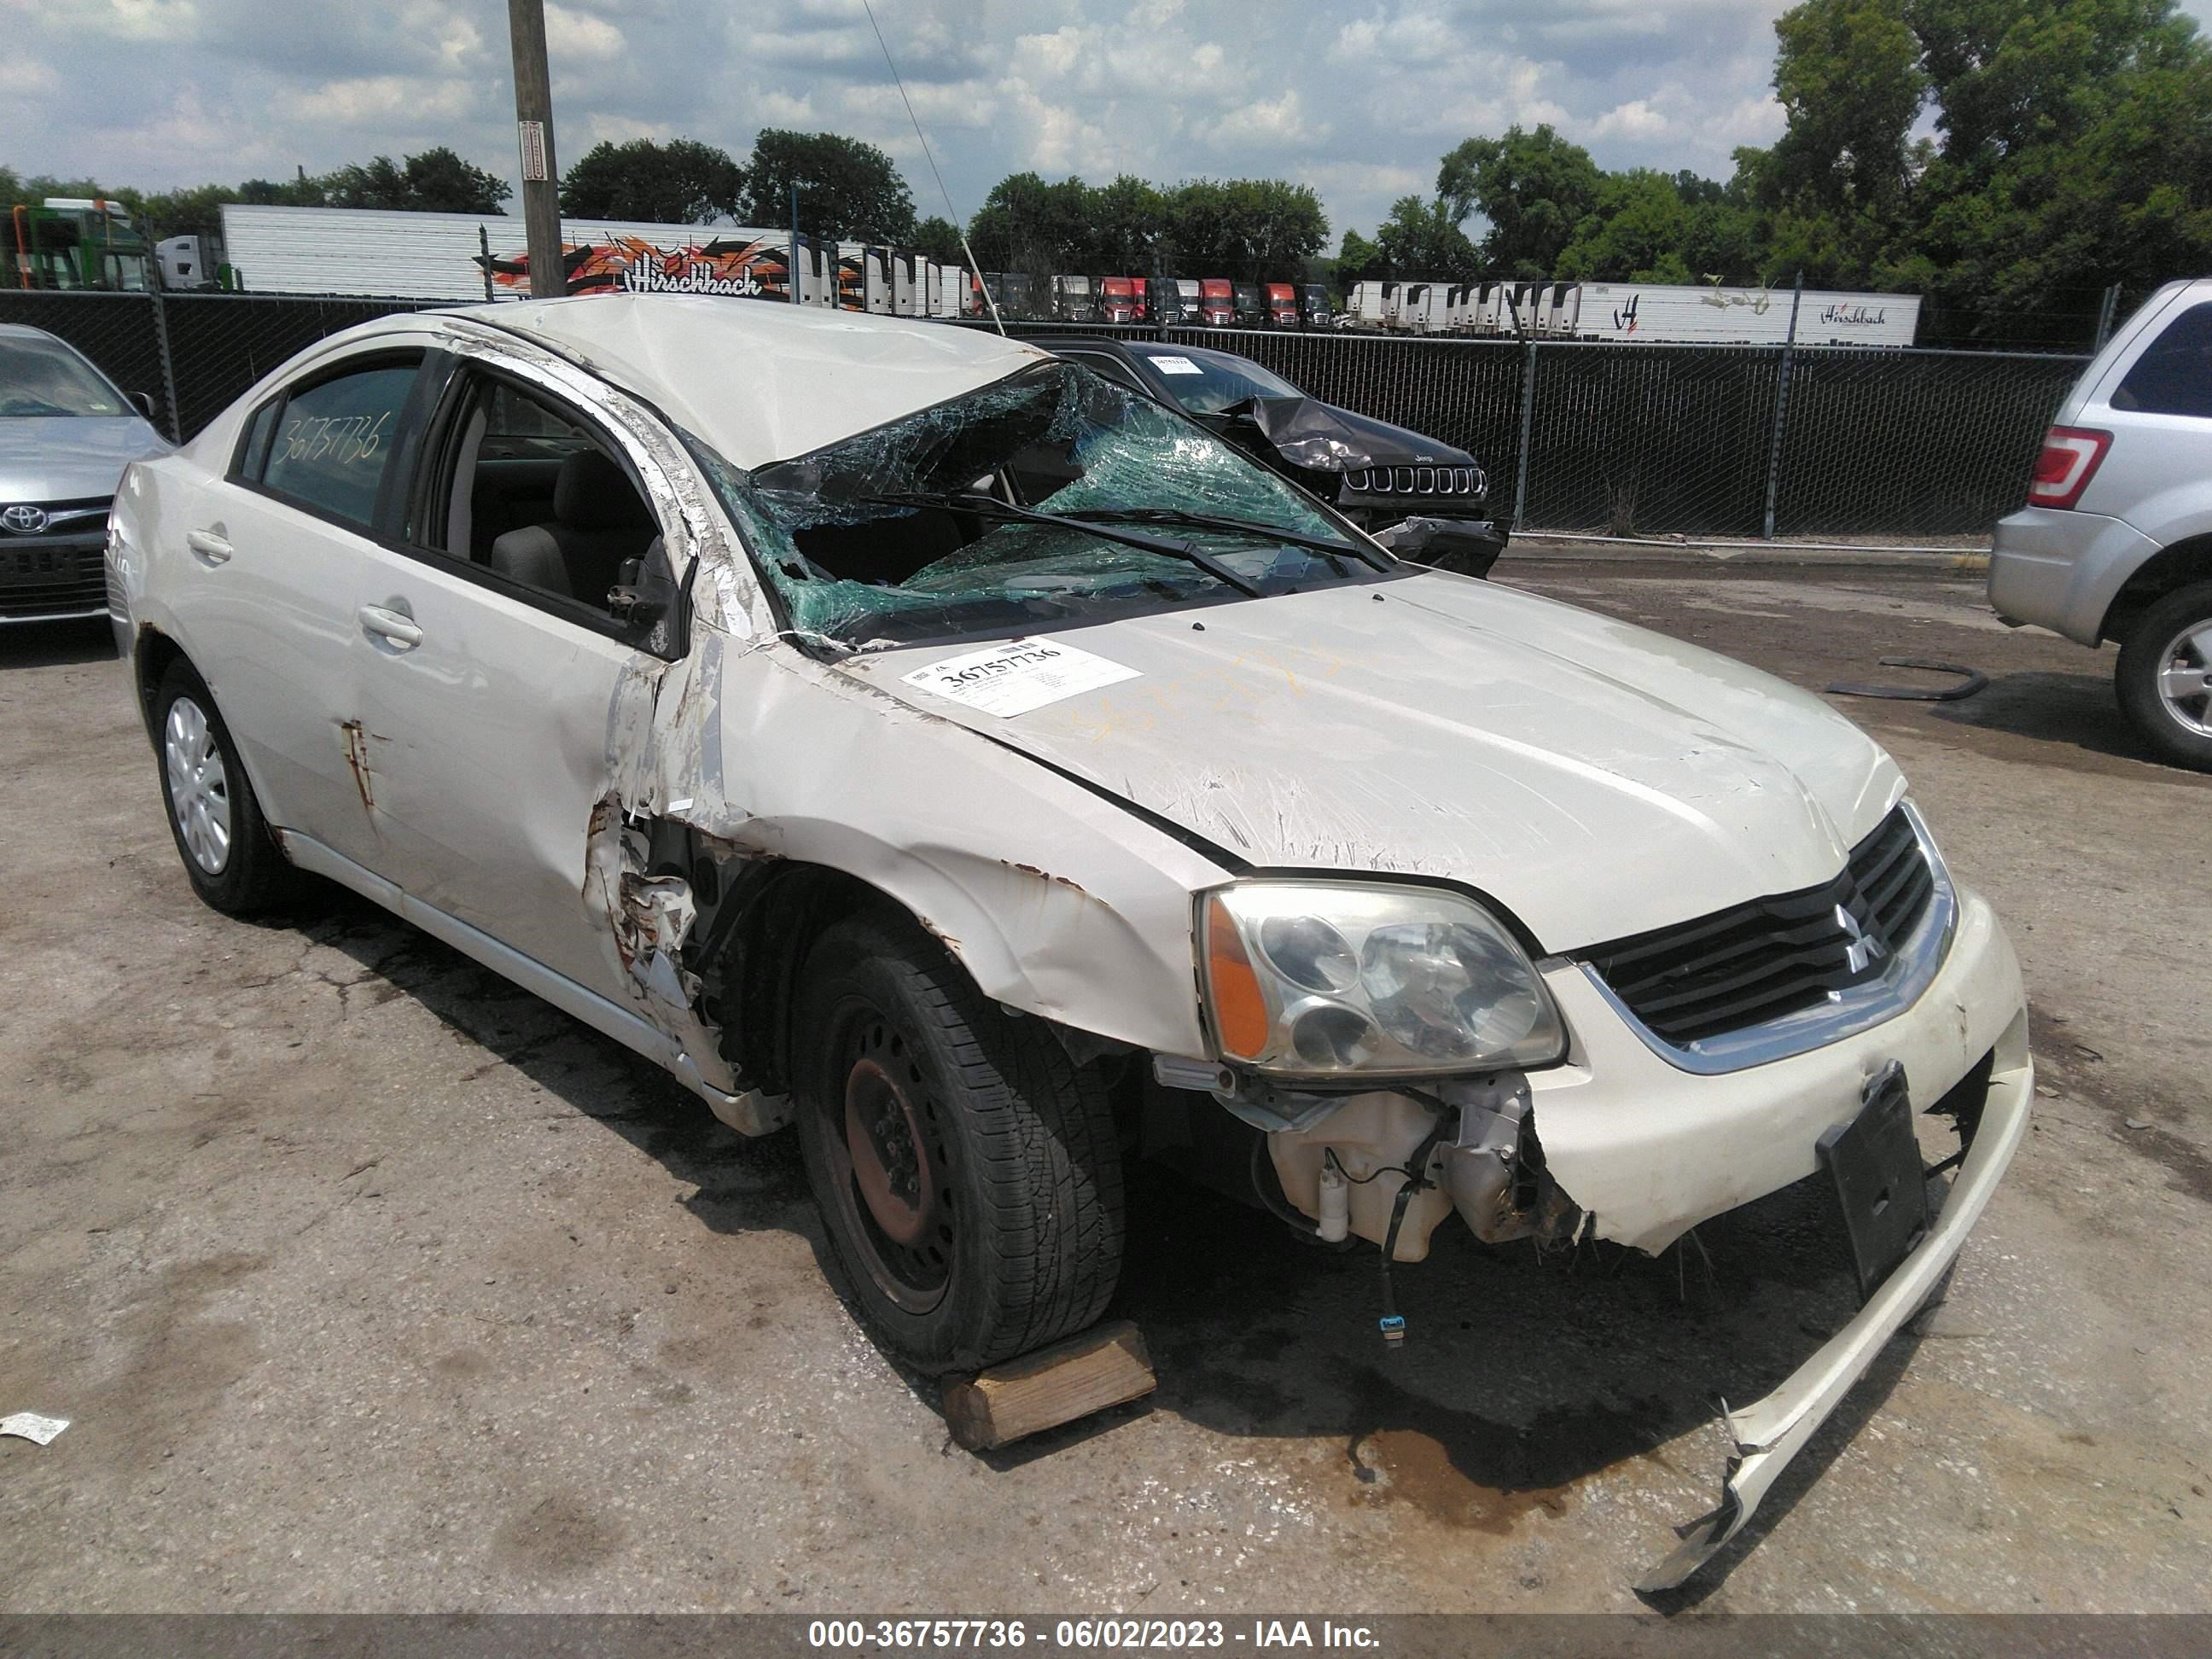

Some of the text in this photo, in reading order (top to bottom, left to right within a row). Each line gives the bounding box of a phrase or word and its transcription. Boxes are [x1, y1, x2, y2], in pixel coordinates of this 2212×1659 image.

[623, 251, 763, 295] Hirschbach
[1820, 304, 1885, 325] Hirschbach
[275, 410, 392, 465] 36757736
[1414, 454, 1434, 463] Jeep
[940, 648, 1062, 688] 36757736
